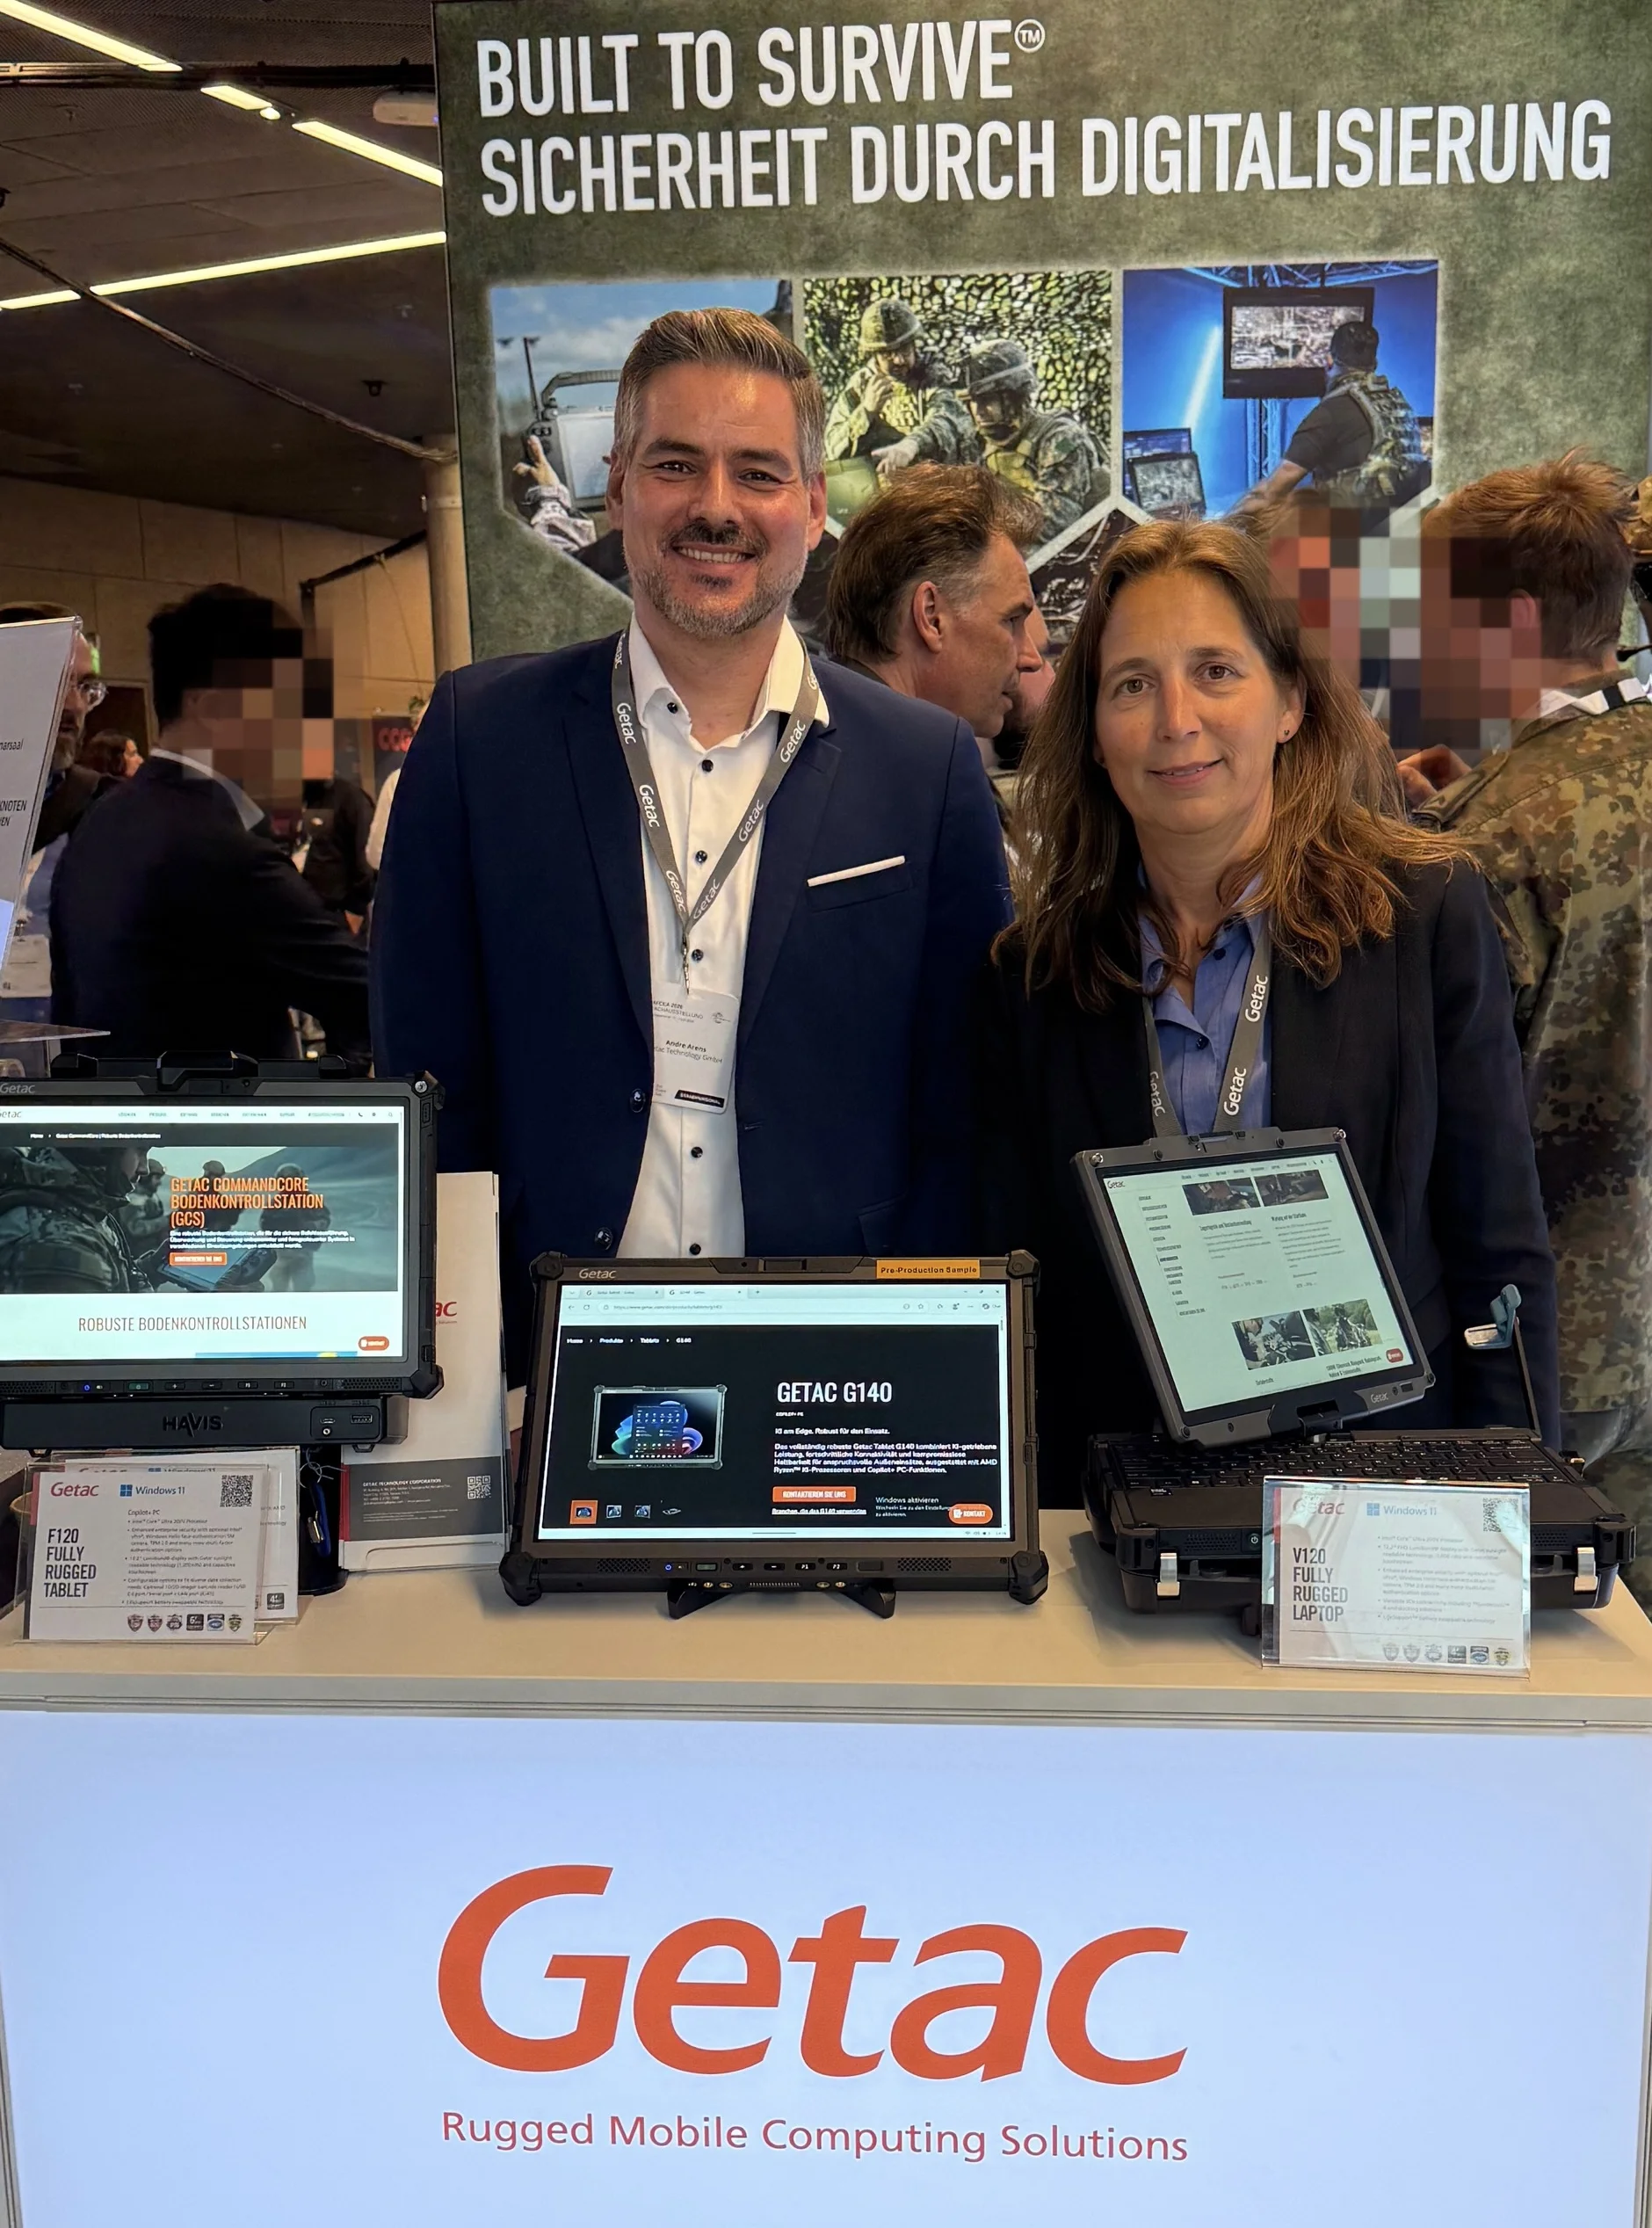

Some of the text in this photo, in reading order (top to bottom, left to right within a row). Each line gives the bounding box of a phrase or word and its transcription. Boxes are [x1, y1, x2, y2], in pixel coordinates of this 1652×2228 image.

[478, 34, 638, 116] BUILT
[658, 30, 732, 109] TO
[758, 19, 1012, 106] SURVIVE
[482, 100, 1612, 216] SICHERHEIT DURCH DIGITALISIERUNG
[617, 702, 637, 744] Getac
[780, 720, 807, 763] Getac
[639, 784, 660, 828] Getac
[738, 799, 764, 842] Getac
[666, 870, 686, 912] Getac
[692, 878, 721, 919] Getac
[1245, 974, 1268, 1022] Getac
[666, 1040, 686, 1049] Andre
[0, 1083, 35, 1094] Getac
[1223, 1067, 1247, 1116] Getac
[170, 1177, 309, 1192] GETAC COMMANDCORE
[170, 1194, 323, 1209] BODENKONTROLLSTATION
[170, 1211, 206, 1229] (GCS)
[578, 1267, 617, 1279] Getac
[78, 1316, 307, 1332] ROBUSTE BODENKONTROLLSTATIONEN
[777, 1382, 893, 1403] GETAC G140
[163, 1412, 224, 1438] HAVIS
[50, 1481, 185, 1497] Getac Windows 11
[1384, 1505, 1428, 1515] Windows
[47, 1528, 79, 1543] F120
[47, 1546, 85, 1561] FULLY
[1293, 1547, 1326, 1564] V120
[45, 1564, 97, 1579] RUGGED
[1293, 1566, 1334, 1583] FULLY
[44, 1582, 89, 1597] TABLET
[1293, 1585, 1348, 1603] RUGGED
[1293, 1604, 1344, 1622] LAPTOP
[438, 1864, 1188, 2086] Getac
[442, 2112, 1189, 2163] Rugged Mobile Computing Solutions
